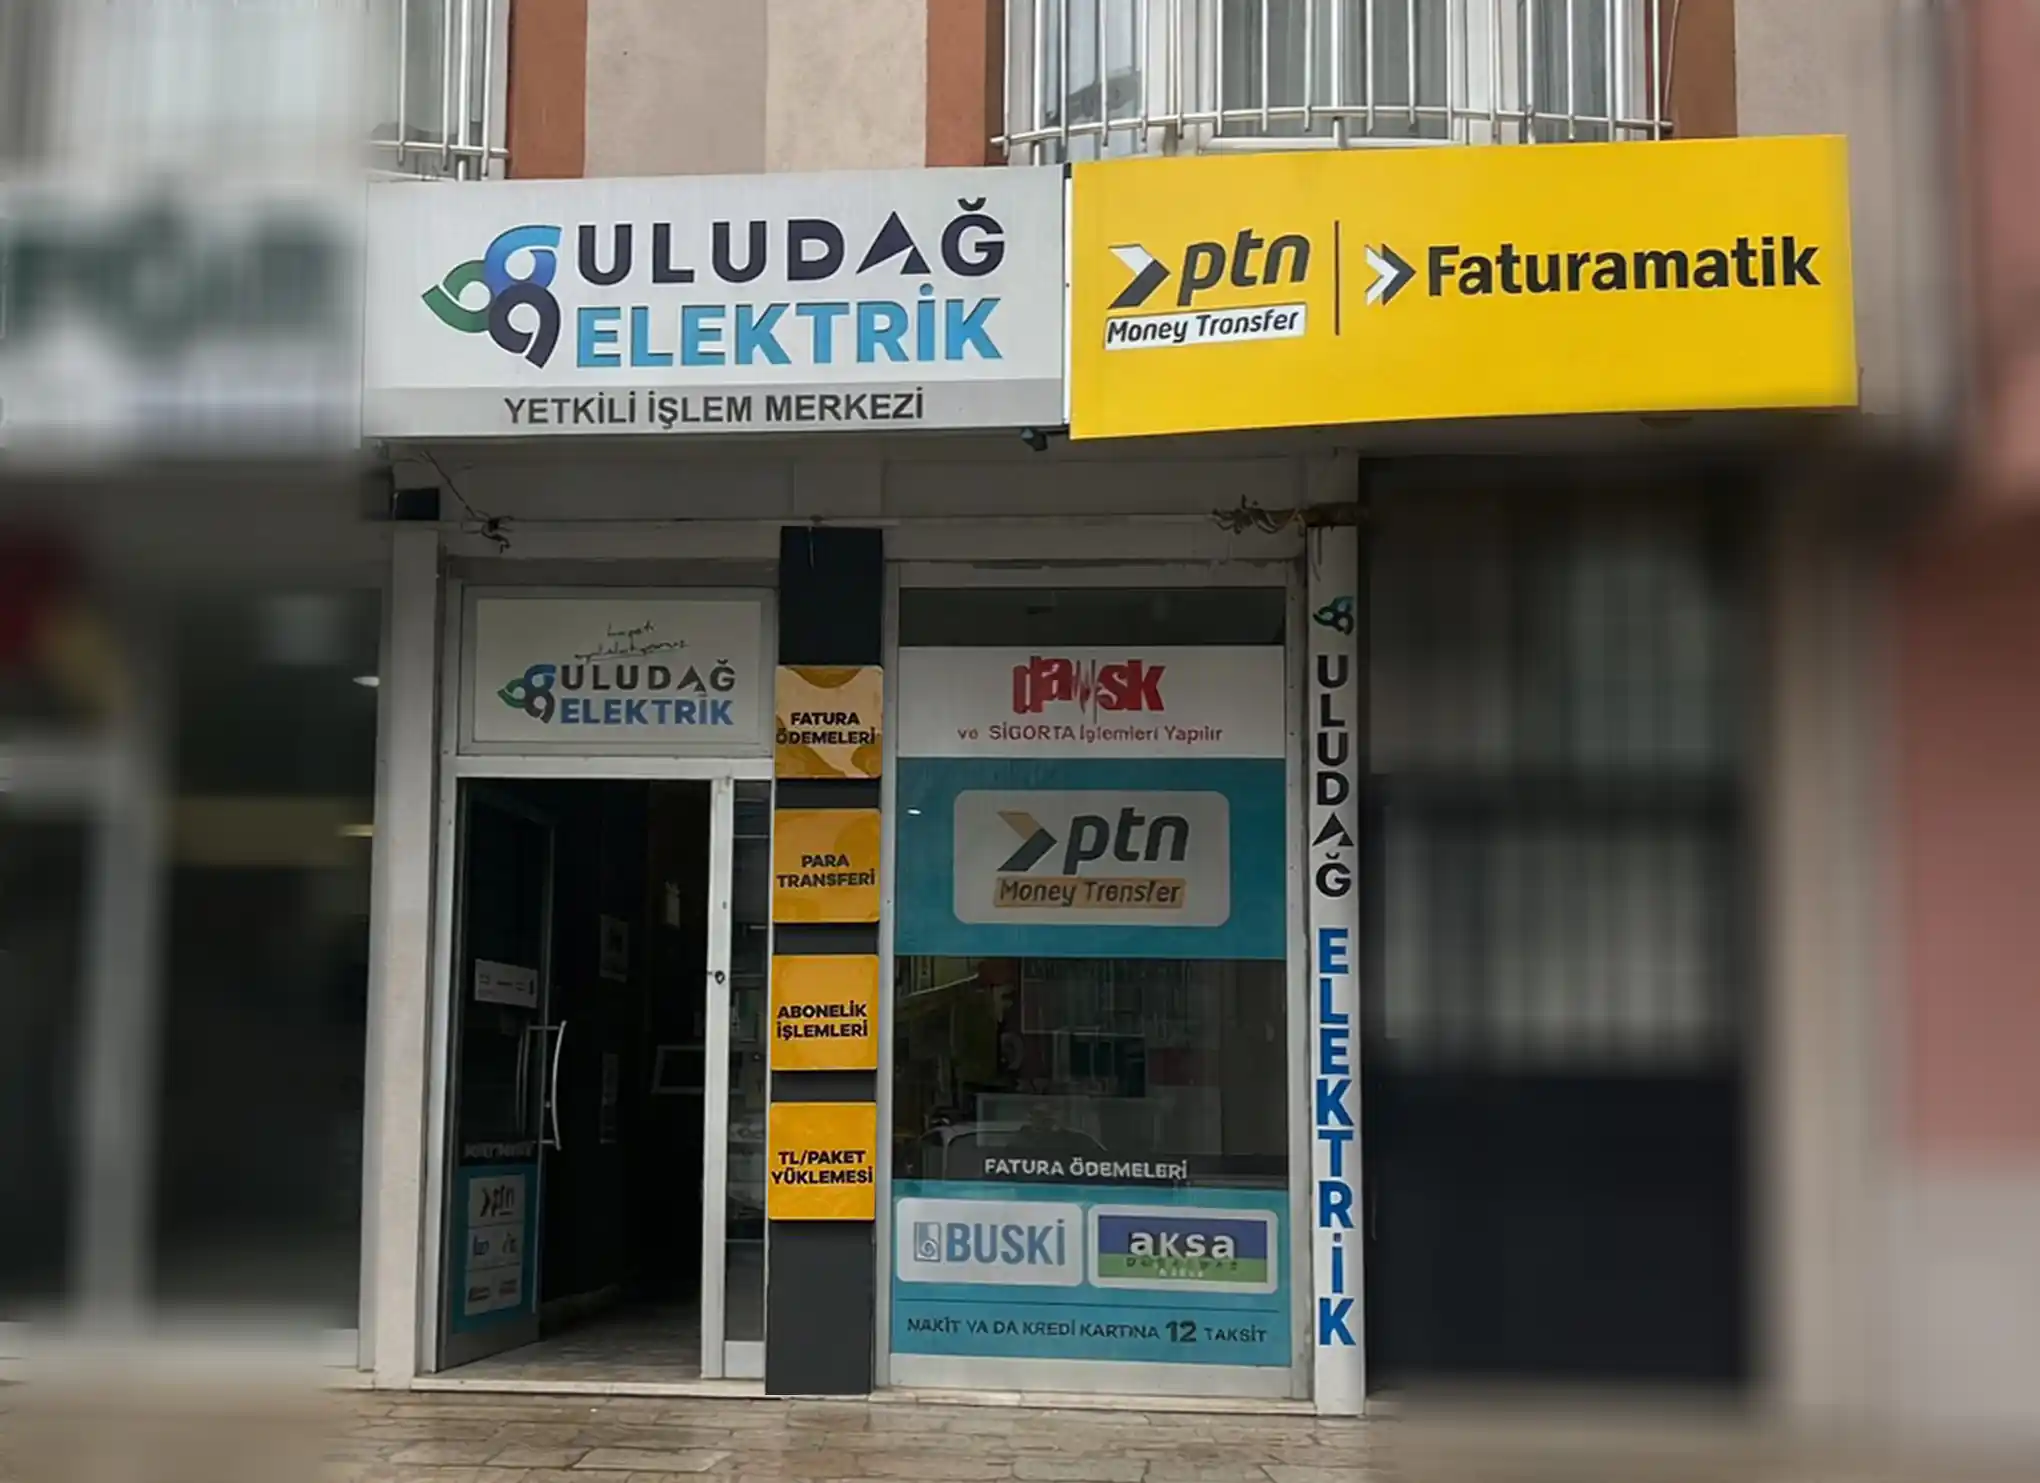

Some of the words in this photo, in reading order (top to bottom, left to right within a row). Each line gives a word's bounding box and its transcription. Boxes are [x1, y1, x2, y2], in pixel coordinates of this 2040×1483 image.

[577, 197, 1005, 286] ULUDAĞ
[1177, 227, 1310, 307] ptn
[1428, 235, 1821, 297] Faturamatik
[576, 283, 1003, 369] ELEKTRİK
[1106, 313, 1188, 345] Money
[1196, 308, 1299, 338] Transfer
[504, 390, 637, 426] YETKİLİ
[647, 388, 753, 431] İŞLEM
[765, 385, 924, 423] MERKEZİ
[560, 658, 736, 692] ULUDAĞ
[560, 693, 735, 726] ELEKTRİK
[790, 712, 860, 726] FATURA
[775, 727, 876, 745] ÖDEMELERİ
[988, 722, 1075, 741] SİGORTA
[1164, 725, 1223, 745] Yapılır
[1312, 655, 1354, 898] ULUDAĞ
[1062, 807, 1190, 875] ptn
[801, 854, 850, 868] PARA
[776, 868, 876, 889] TRANSFERİ
[1000, 880, 1077, 907] Money
[777, 1000, 867, 1019] ABONELİK
[776, 1020, 868, 1040] İŞLEMLERİ
[1316, 928, 1356, 1346] ELEKTRİK
[778, 1150, 866, 1166] TL/PAKET
[984, 1157, 1064, 1177] FATURA
[1070, 1156, 1188, 1180] ÖDEMELERİ
[771, 1166, 873, 1185] YÜKLEMESİ
[946, 1218, 1066, 1267] BUSKİ
[1130, 1230, 1236, 1260] aksa
[907, 1314, 961, 1335] NAKİT
[993, 1320, 1019, 1336] DA
[1023, 1318, 1076, 1337] KREDİ
[1080, 1322, 1160, 1340] KARTINA
[1165, 1320, 1198, 1343] 12
[1204, 1323, 1269, 1343] TAKSİT
